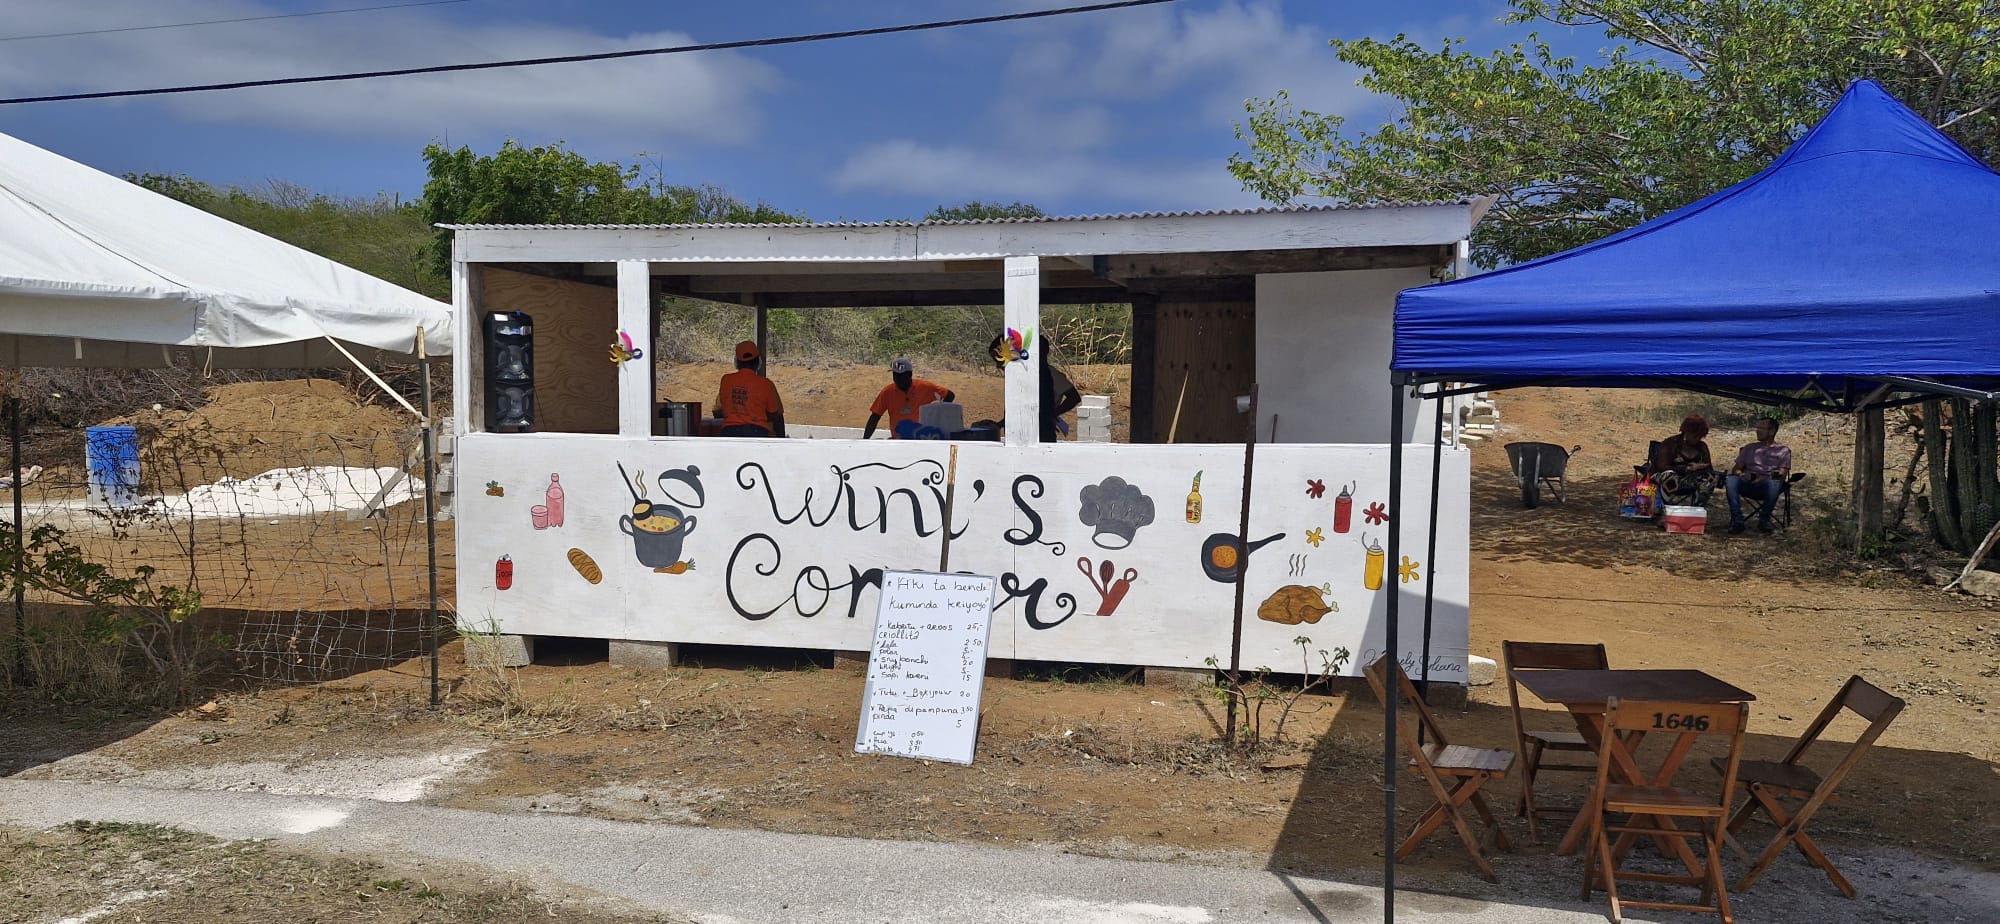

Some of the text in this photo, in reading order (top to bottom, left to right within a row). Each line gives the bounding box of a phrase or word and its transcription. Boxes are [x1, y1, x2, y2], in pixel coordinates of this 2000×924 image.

[726, 532, 1077, 631] Corr
[933, 578, 947, 591] ta
[1652, 712, 1709, 731] 1646
